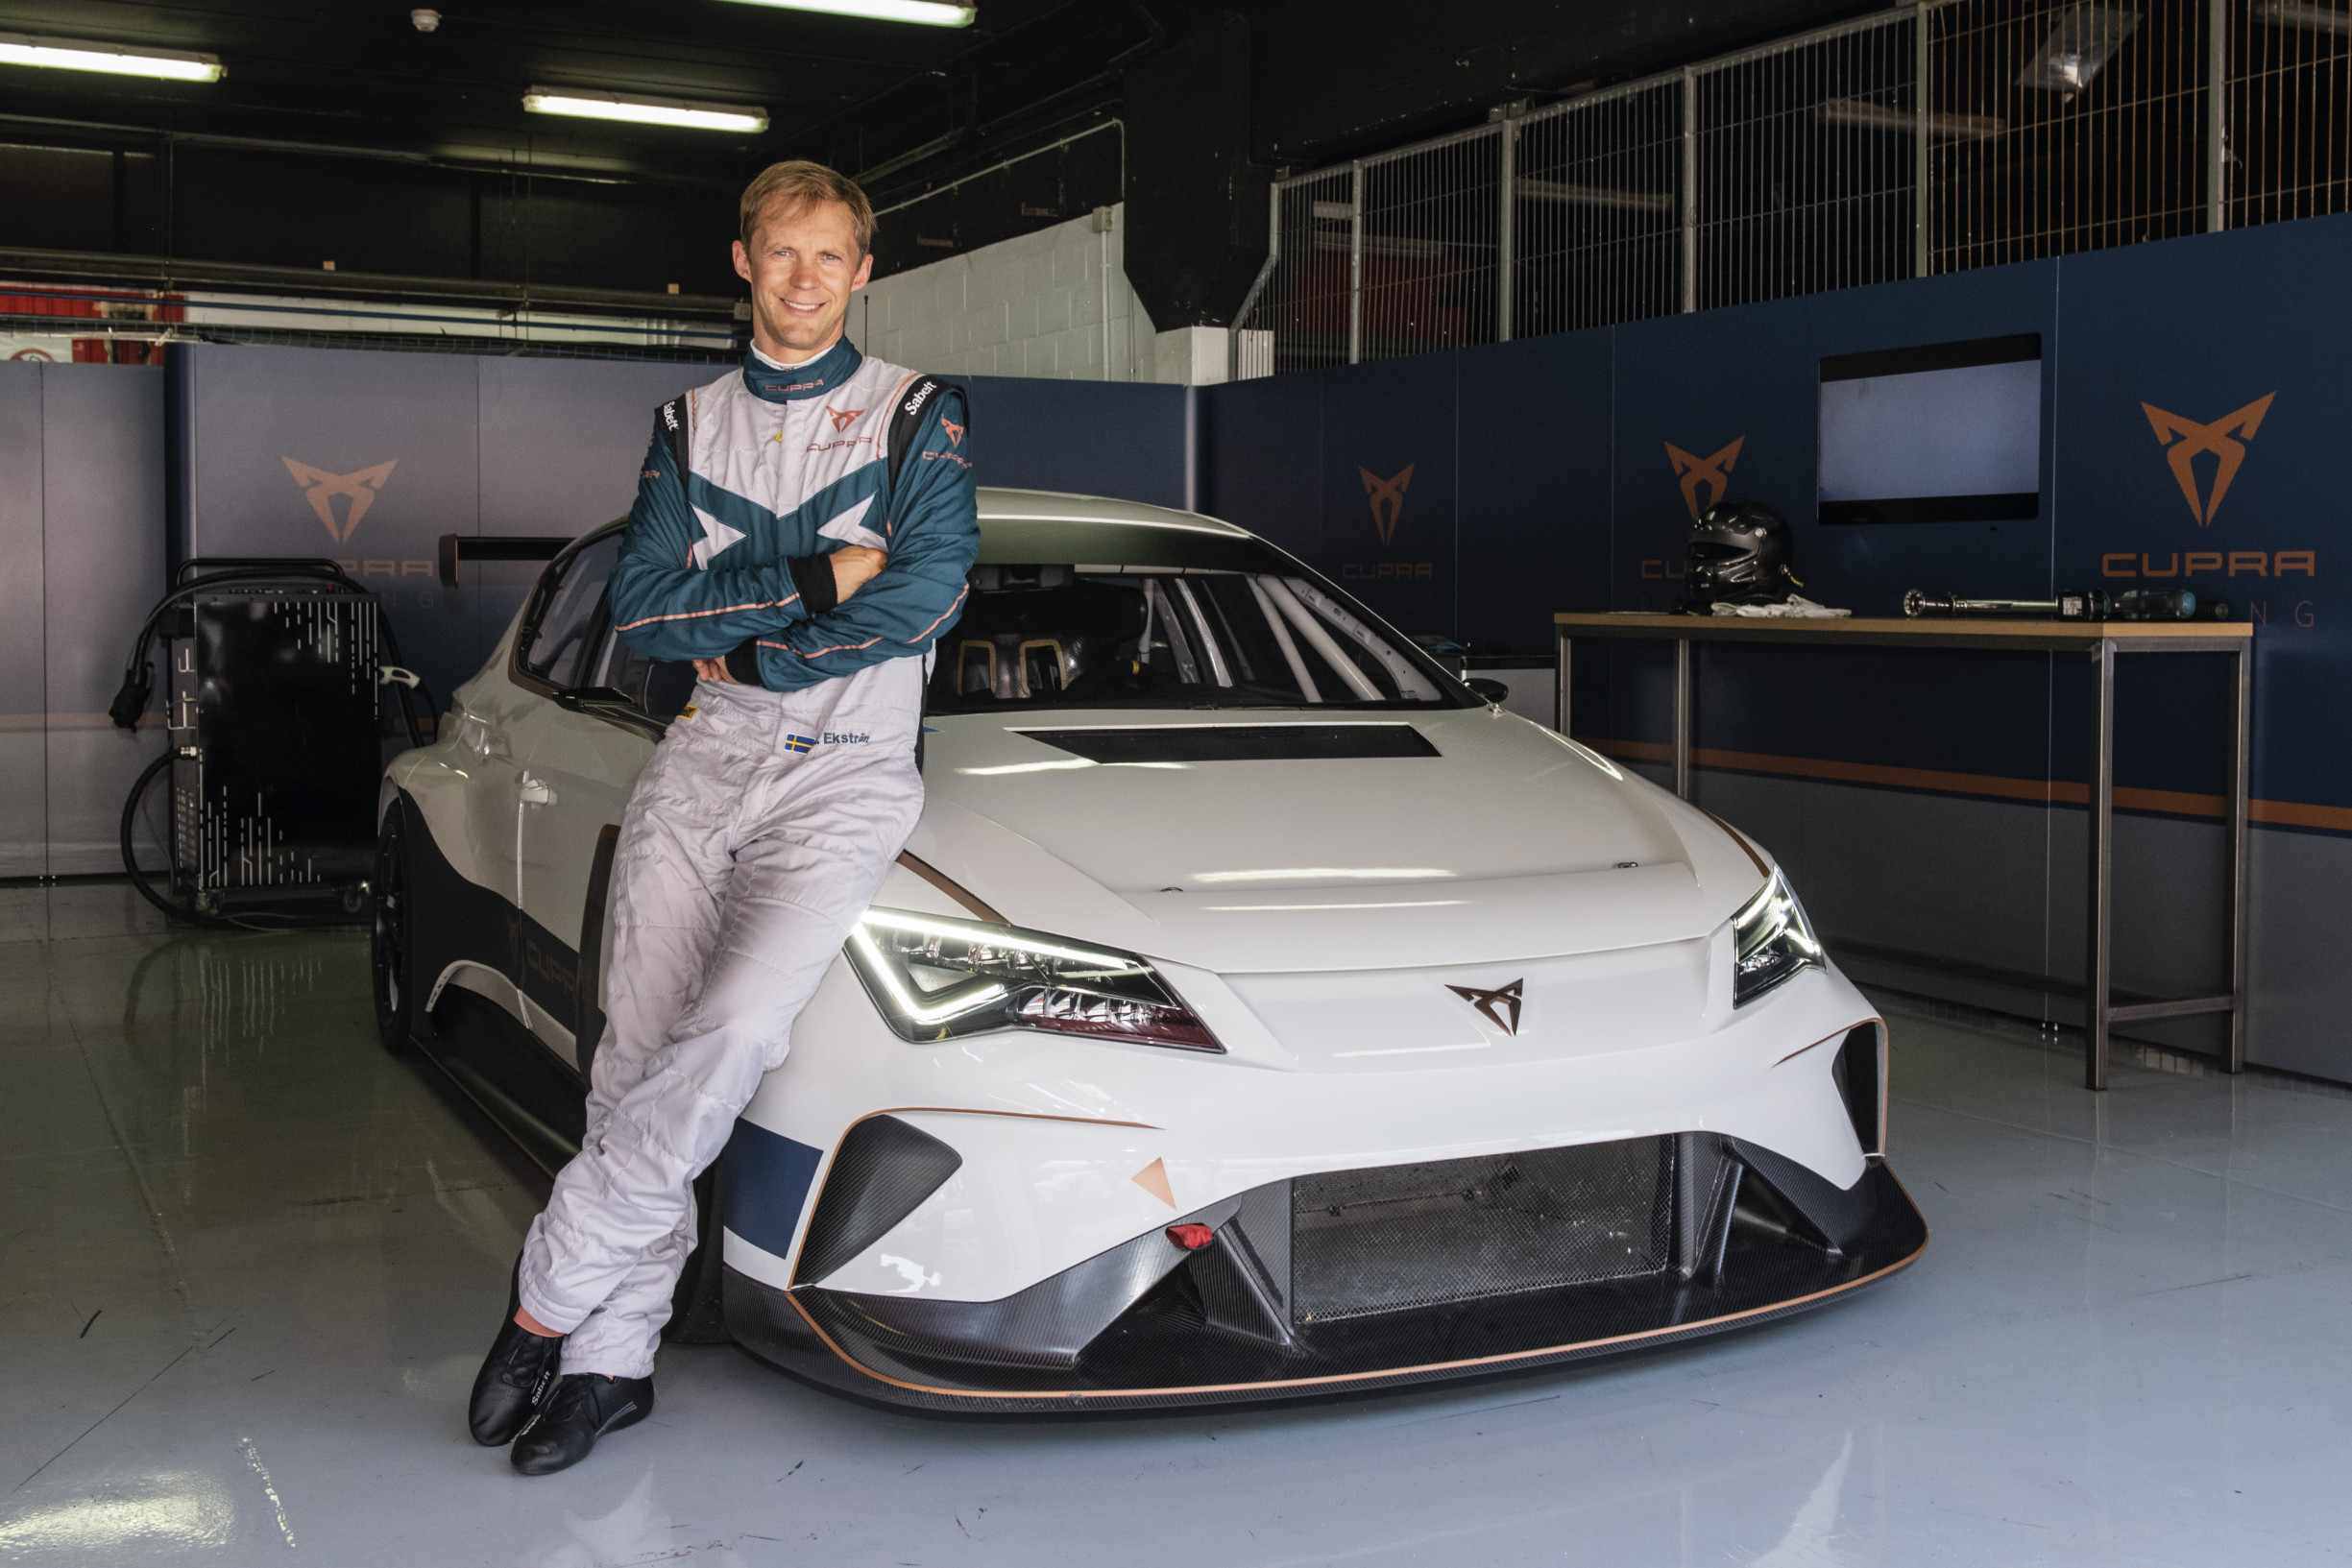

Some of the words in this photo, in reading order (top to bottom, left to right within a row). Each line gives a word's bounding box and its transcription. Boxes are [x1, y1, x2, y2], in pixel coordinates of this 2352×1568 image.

[764, 378, 824, 392] CUPRA
[905, 380, 937, 416] Sabelt
[663, 400, 679, 431] Sabelt
[326, 560, 434, 577] PRA
[1343, 563, 1433, 580] CUPRA
[2102, 550, 2316, 577] CUPRA
[526, 938, 577, 996] CUPR
